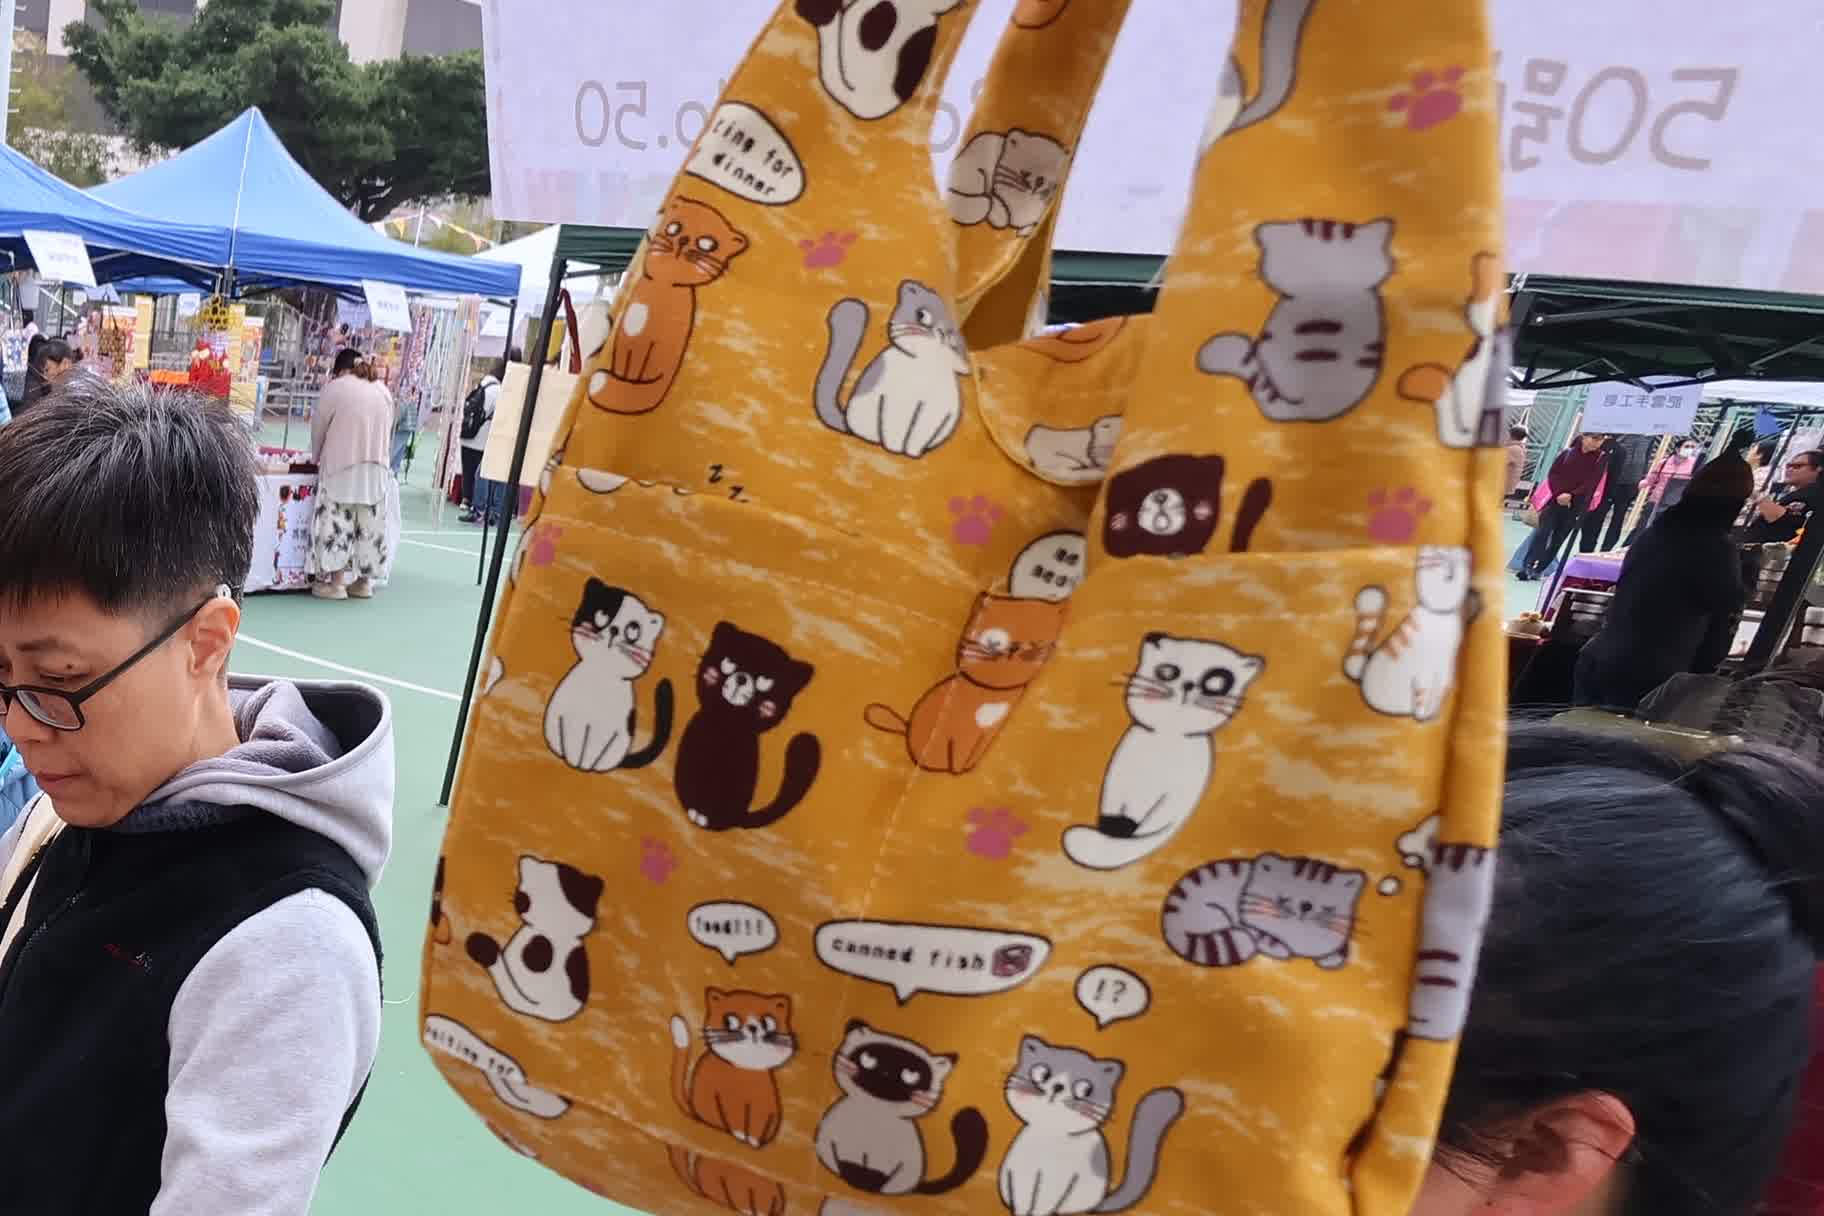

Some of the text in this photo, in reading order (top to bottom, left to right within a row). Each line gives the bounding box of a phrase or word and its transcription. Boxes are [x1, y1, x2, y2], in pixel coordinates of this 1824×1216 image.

[712, 152, 776, 196] dinner
[763, 148, 794, 178] for
[831, 936, 985, 971] canned fish
